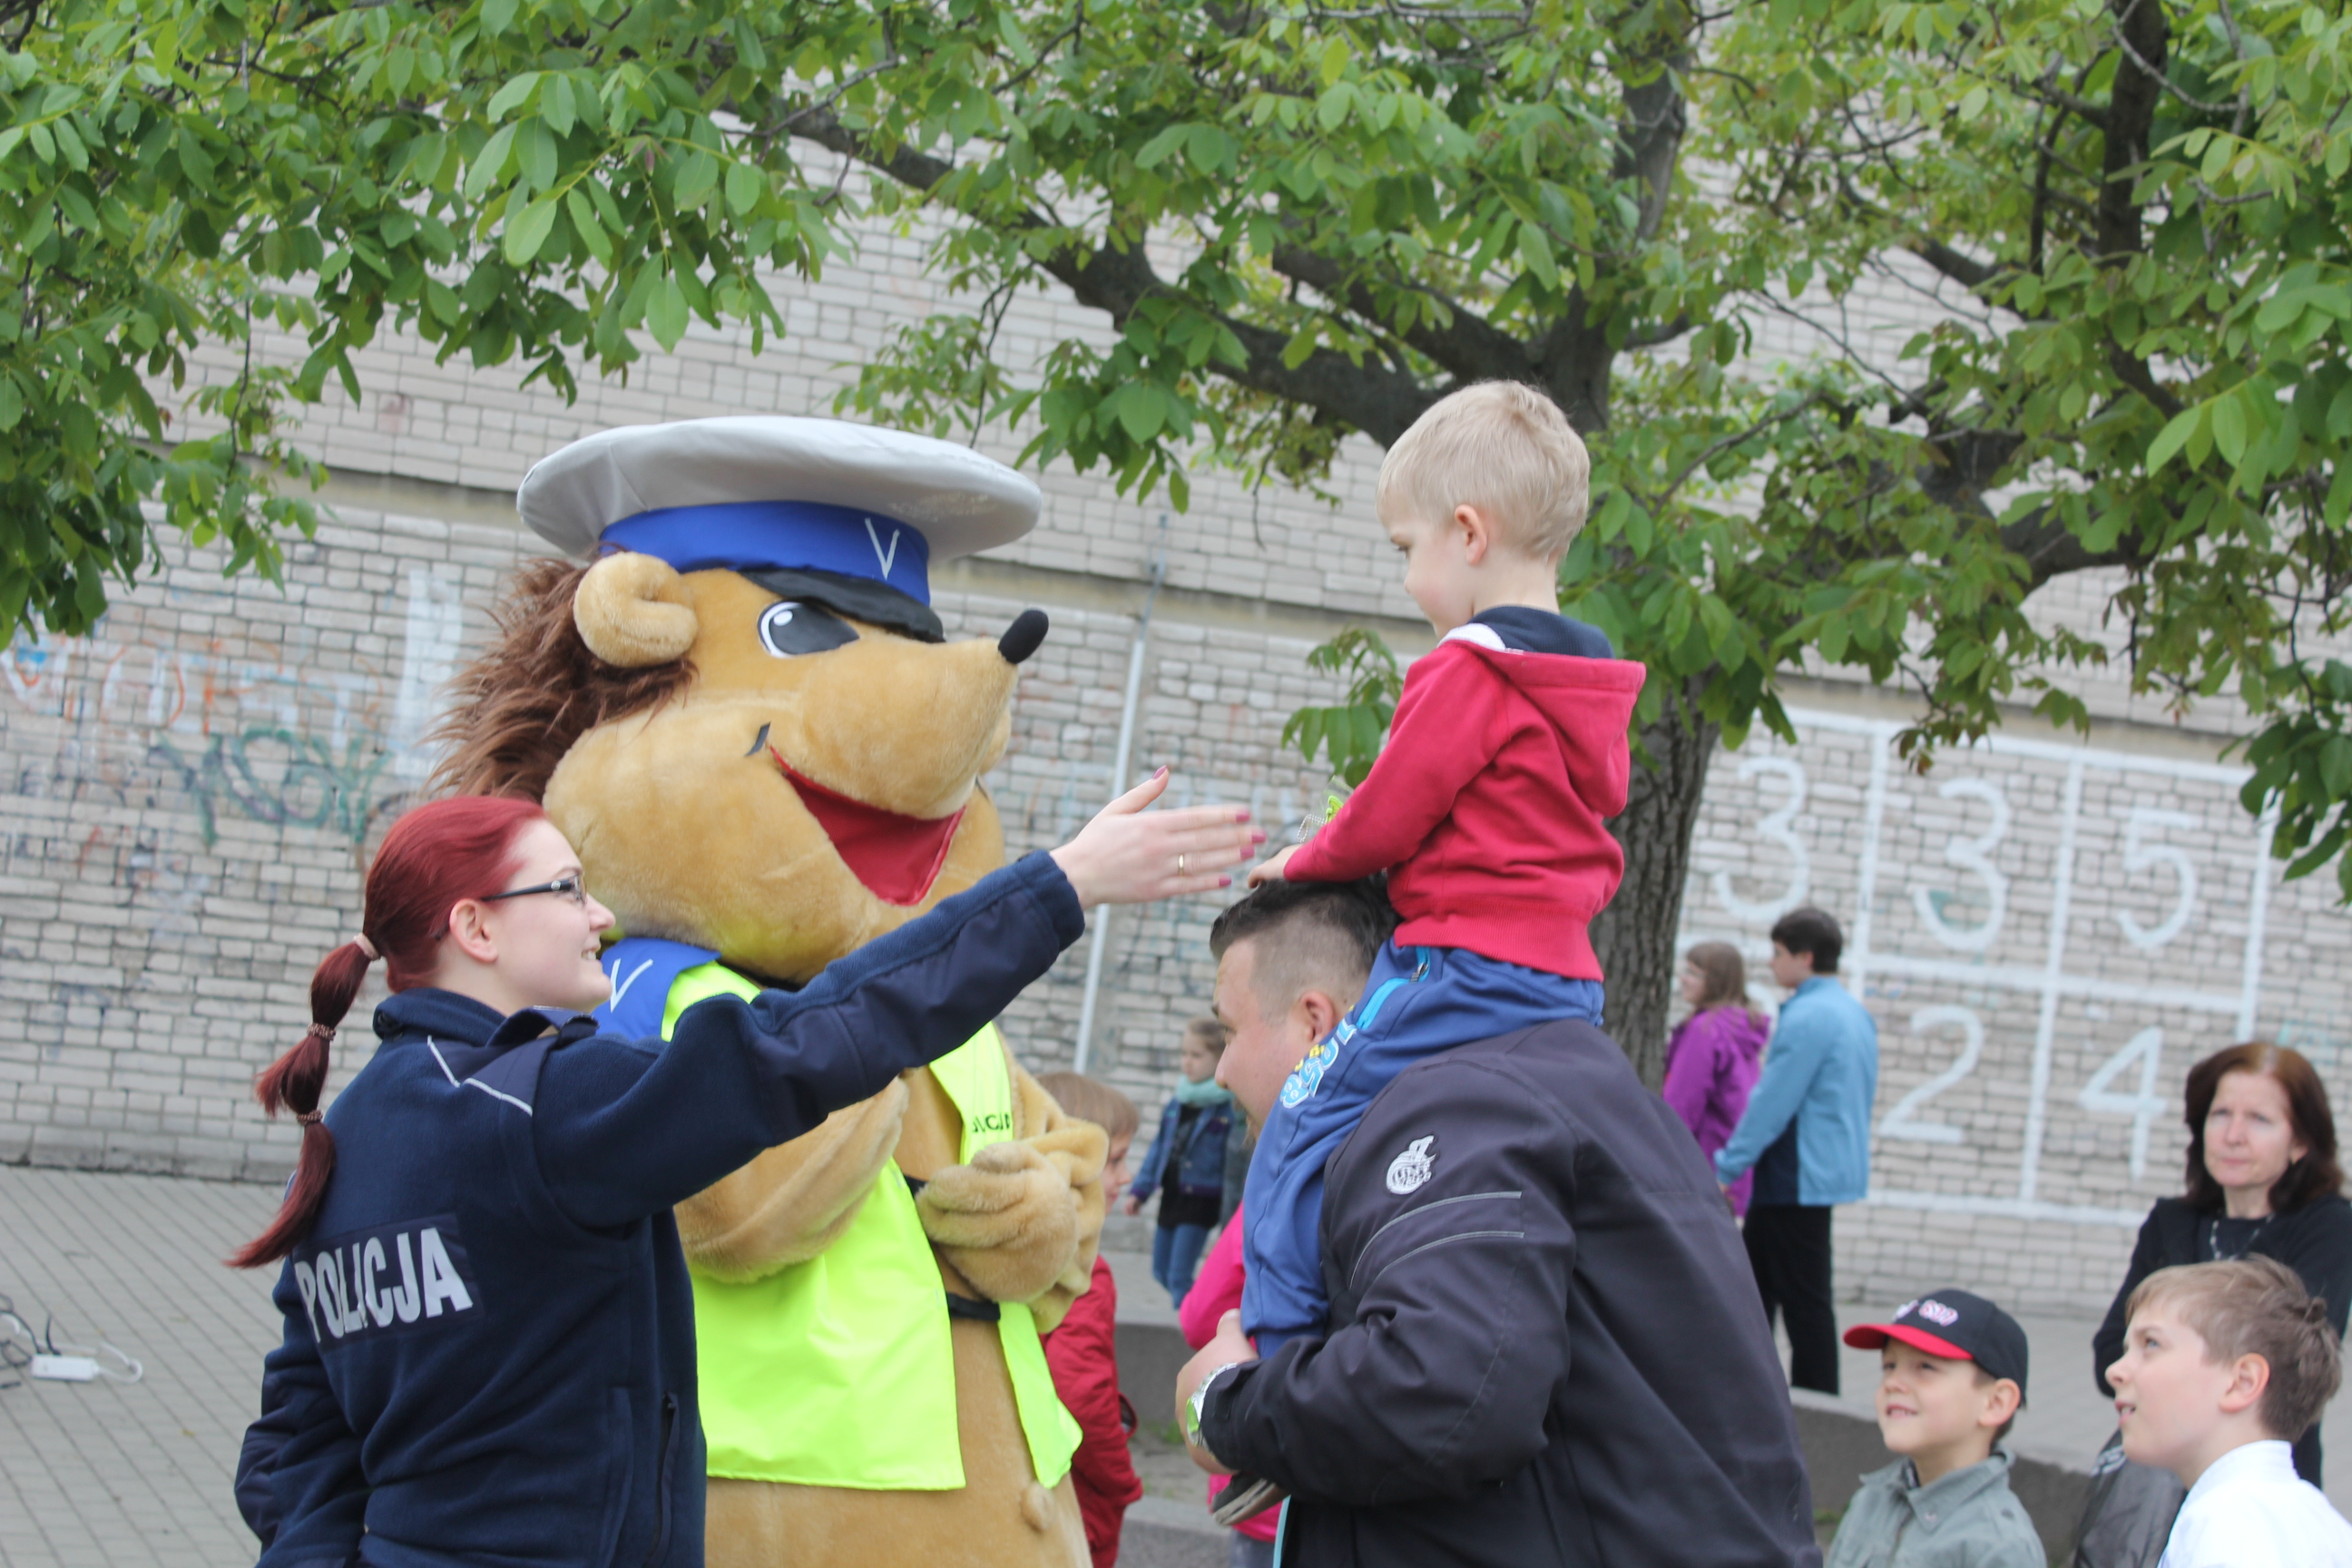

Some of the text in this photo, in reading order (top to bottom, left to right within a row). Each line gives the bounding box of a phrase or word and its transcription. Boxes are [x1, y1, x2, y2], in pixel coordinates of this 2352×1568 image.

[1711, 756, 1810, 922] 3
[1913, 778, 2011, 951] 3
[2118, 807, 2198, 950] 5
[1879, 1004, 1984, 1143] 2
[2079, 1026, 2169, 1181] 4
[295, 1228, 474, 1343] POLICJA
